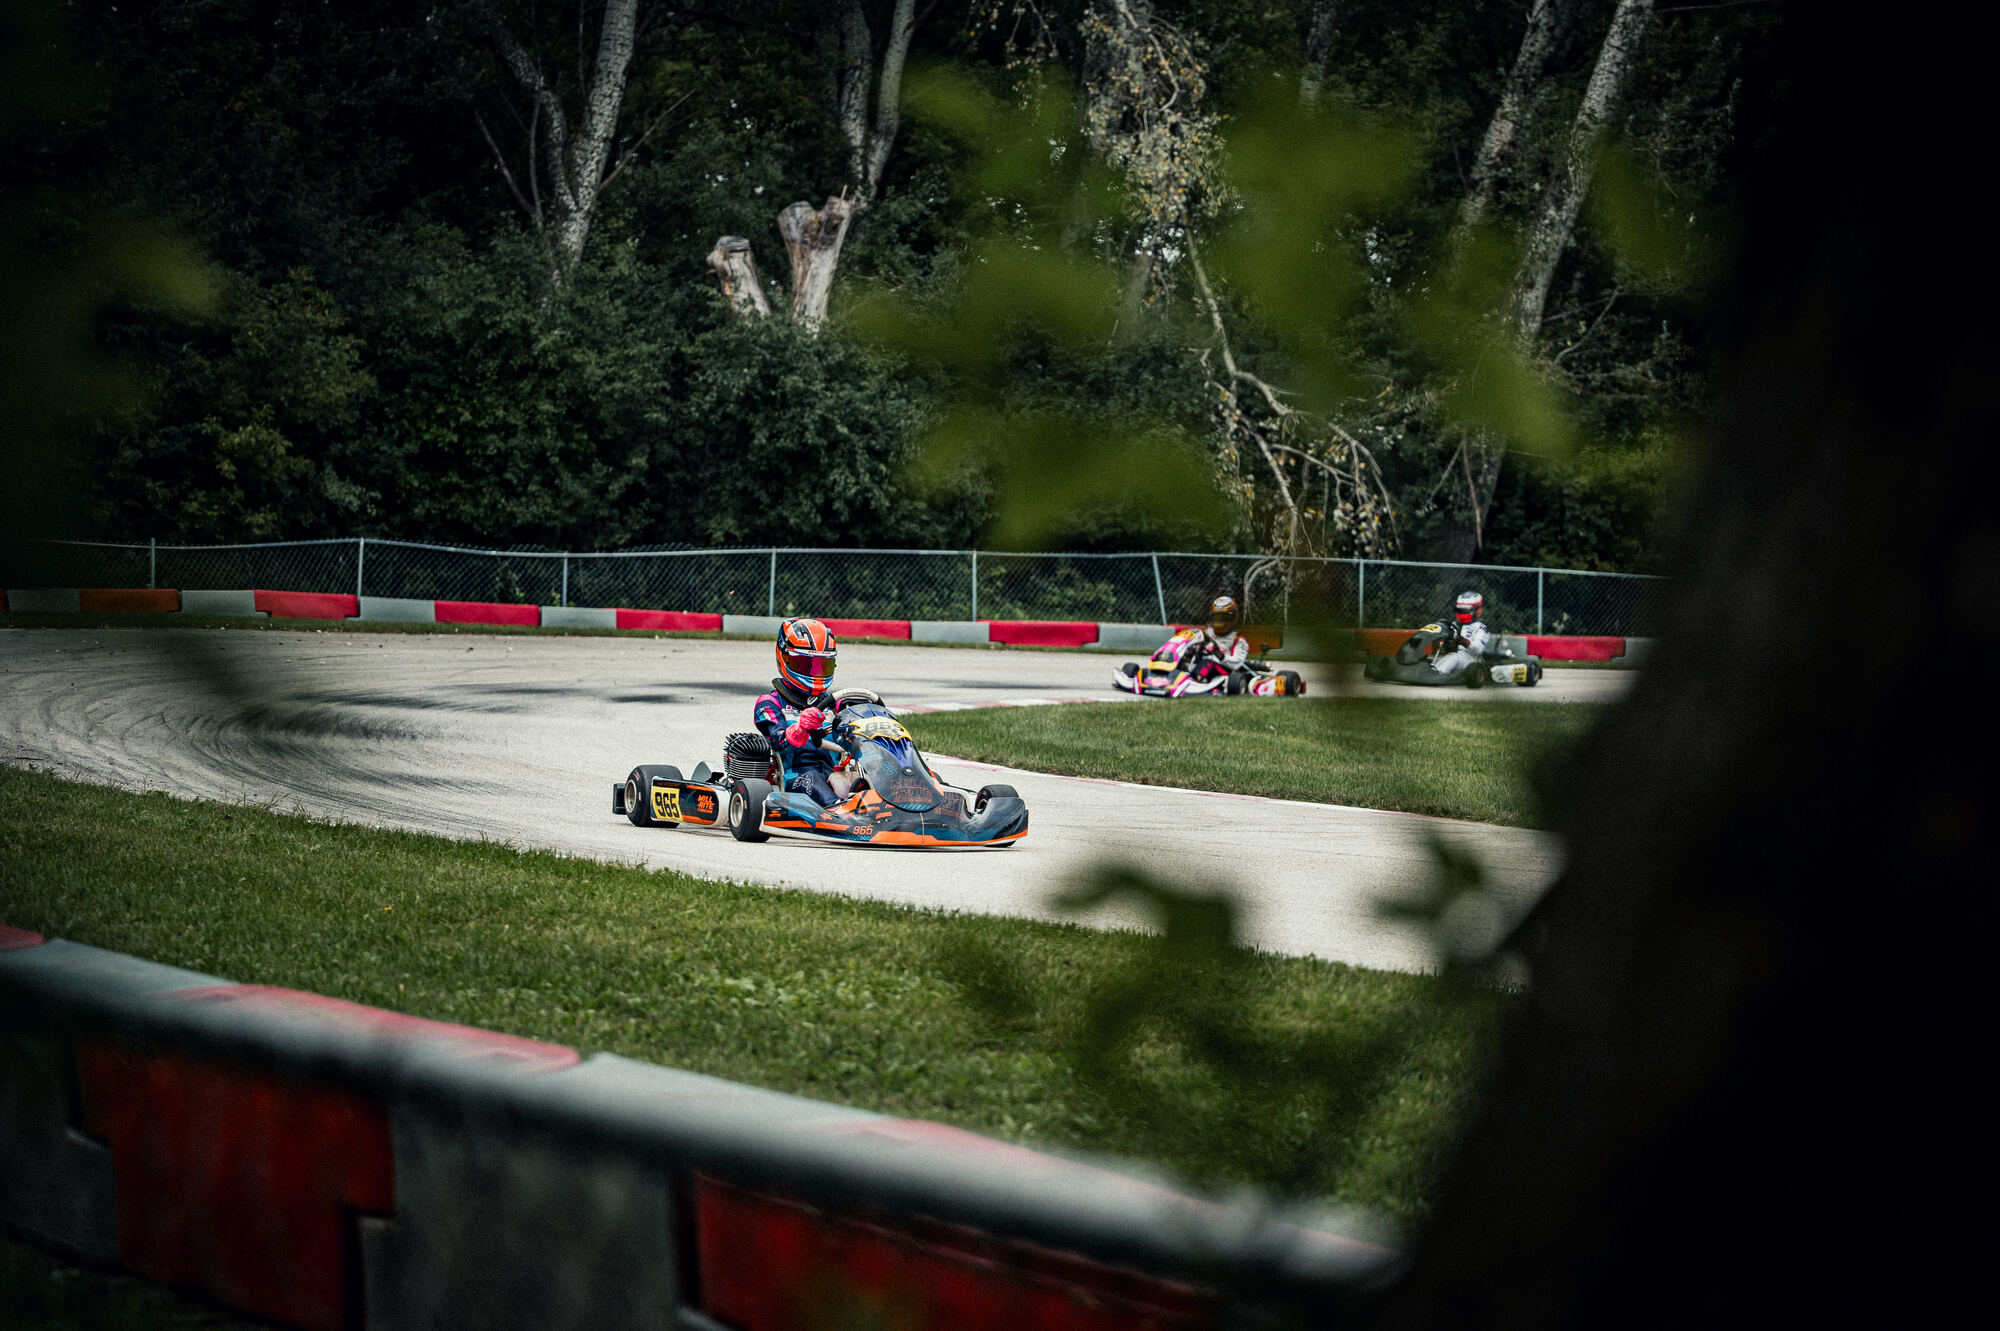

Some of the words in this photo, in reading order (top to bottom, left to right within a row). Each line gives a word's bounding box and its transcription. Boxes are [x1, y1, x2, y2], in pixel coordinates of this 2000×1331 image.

[697, 794, 713, 803] MILL
[655, 792, 680, 818] 965
[852, 824, 874, 835] 965
